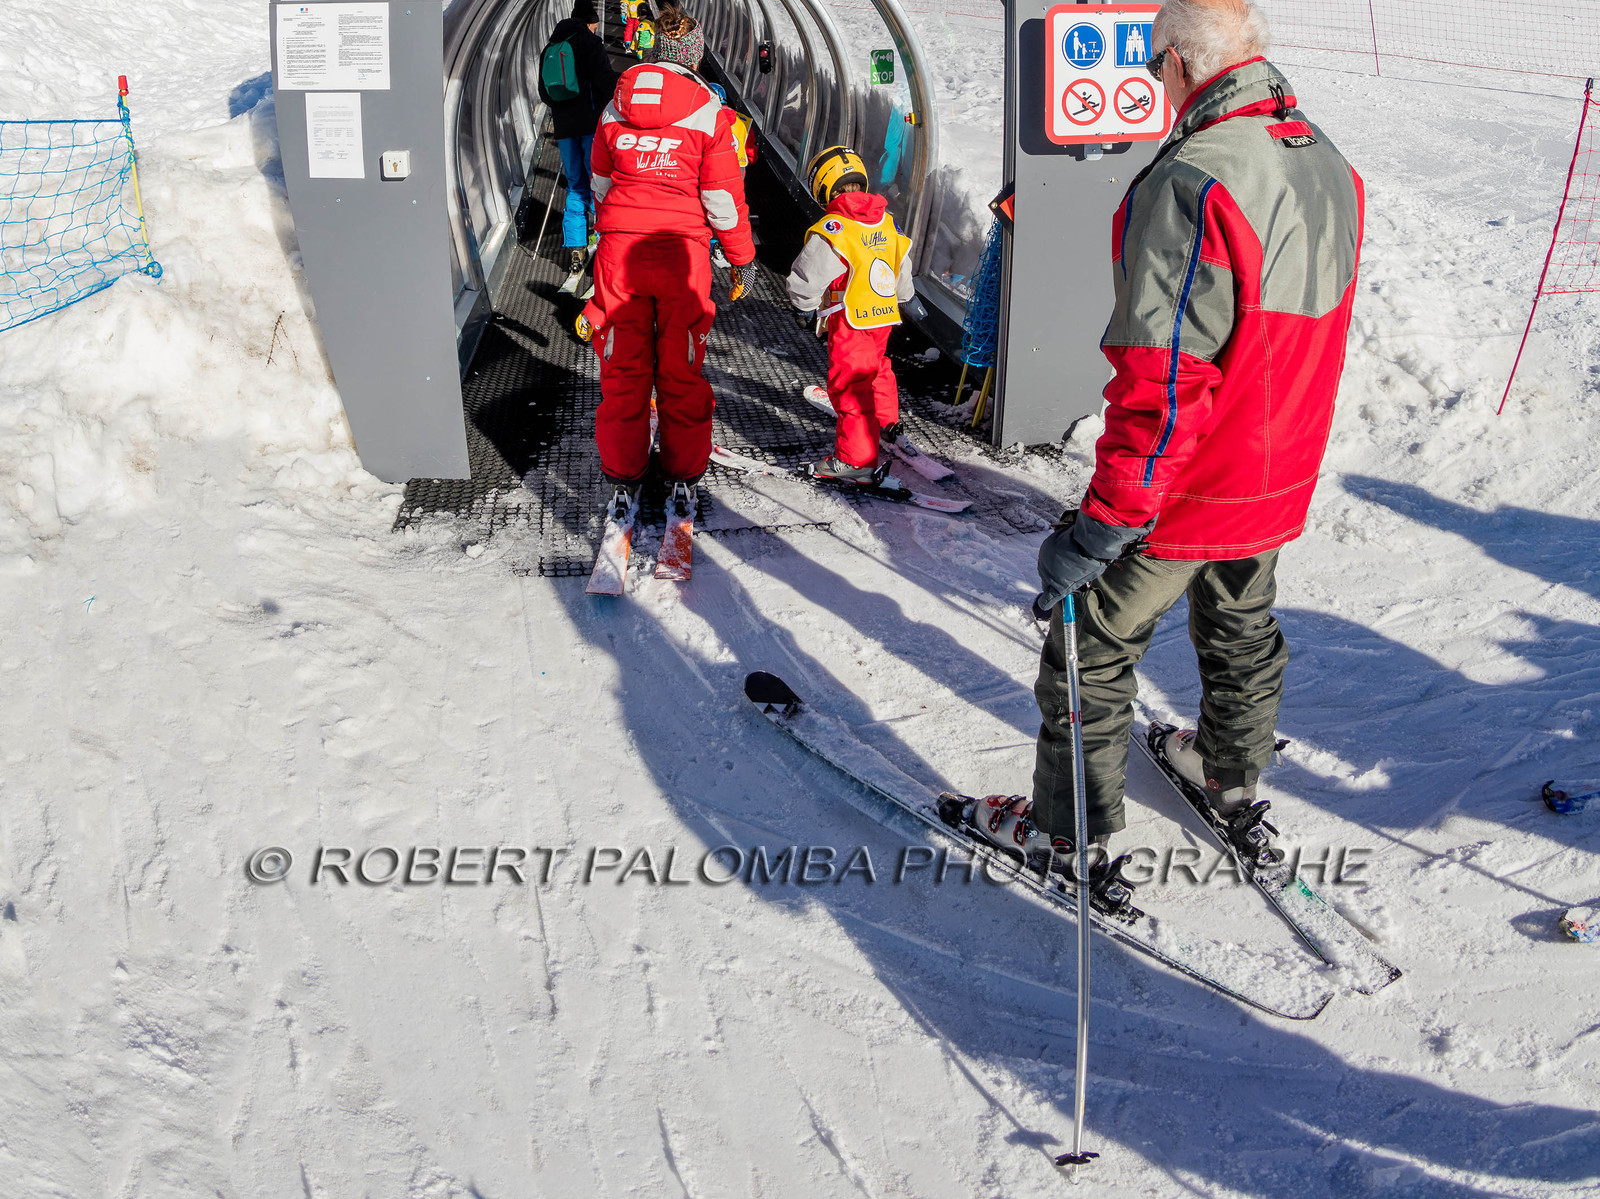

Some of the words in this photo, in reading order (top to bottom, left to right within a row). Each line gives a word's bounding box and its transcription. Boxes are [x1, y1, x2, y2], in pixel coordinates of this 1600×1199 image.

[872, 71, 894, 82] STOP
[636, 152, 650, 169] Val
[650, 153, 678, 169] d'Allos
[855, 308, 868, 319] La
[872, 305, 895, 317] foux
